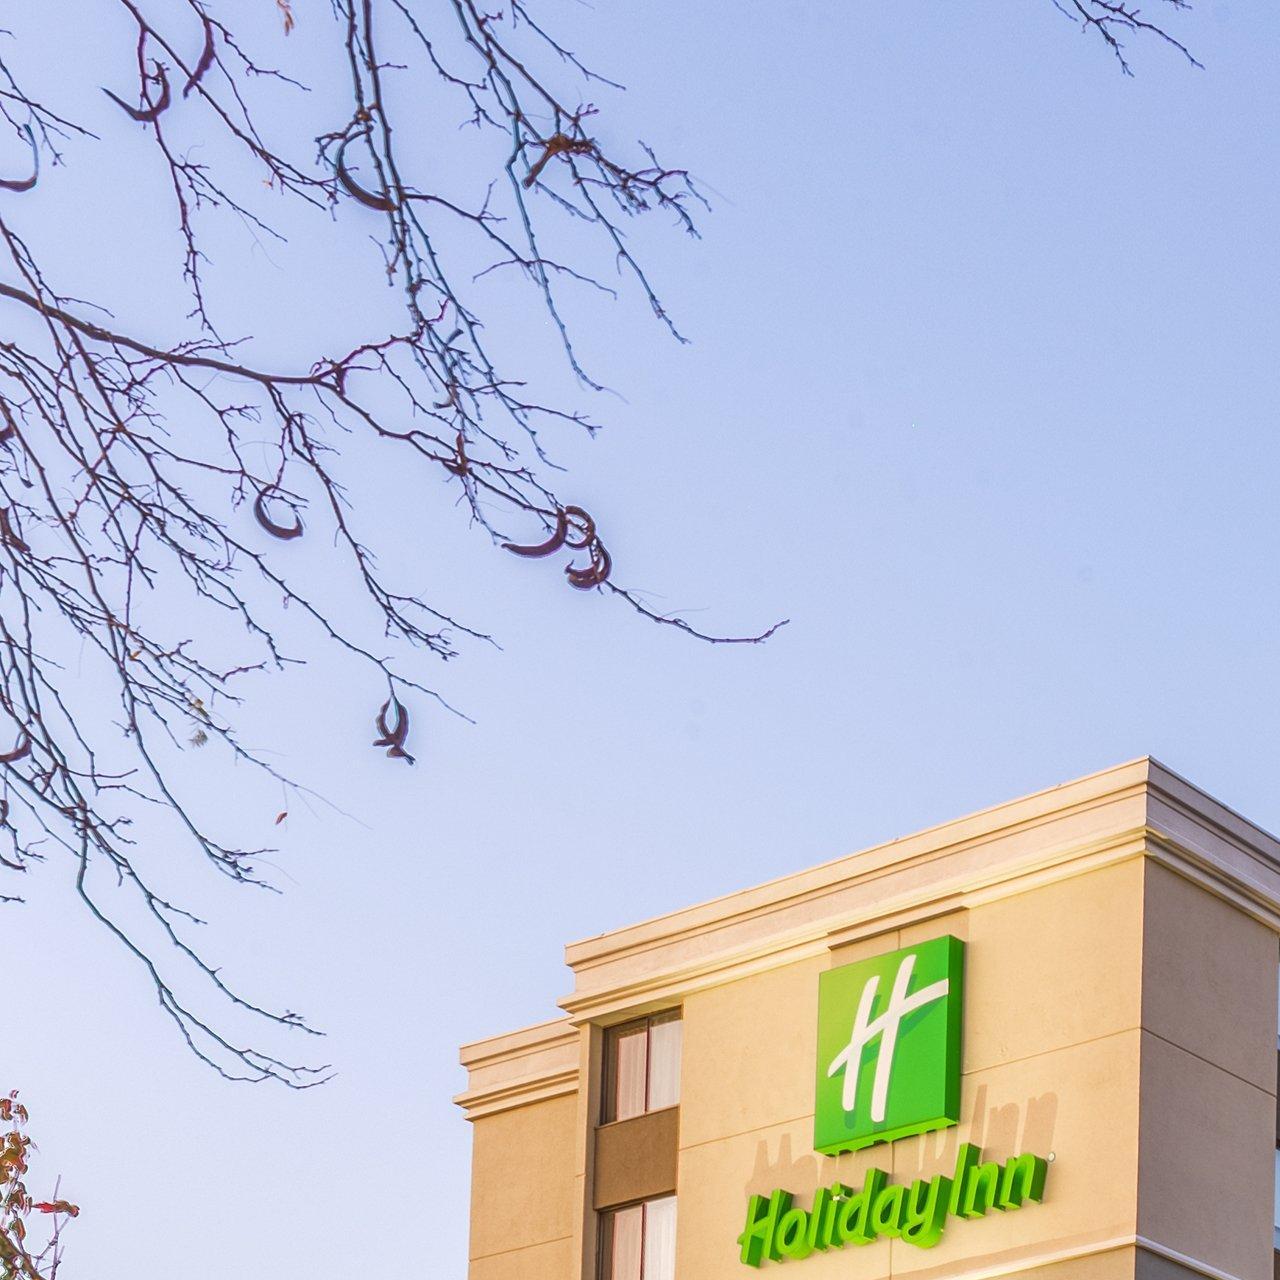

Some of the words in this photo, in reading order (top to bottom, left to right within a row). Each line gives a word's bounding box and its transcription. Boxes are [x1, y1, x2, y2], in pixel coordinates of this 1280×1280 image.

[827, 953, 949, 1123] H
[737, 1167, 953, 1269] Holiday
[950, 1142, 1048, 1220] Inn
